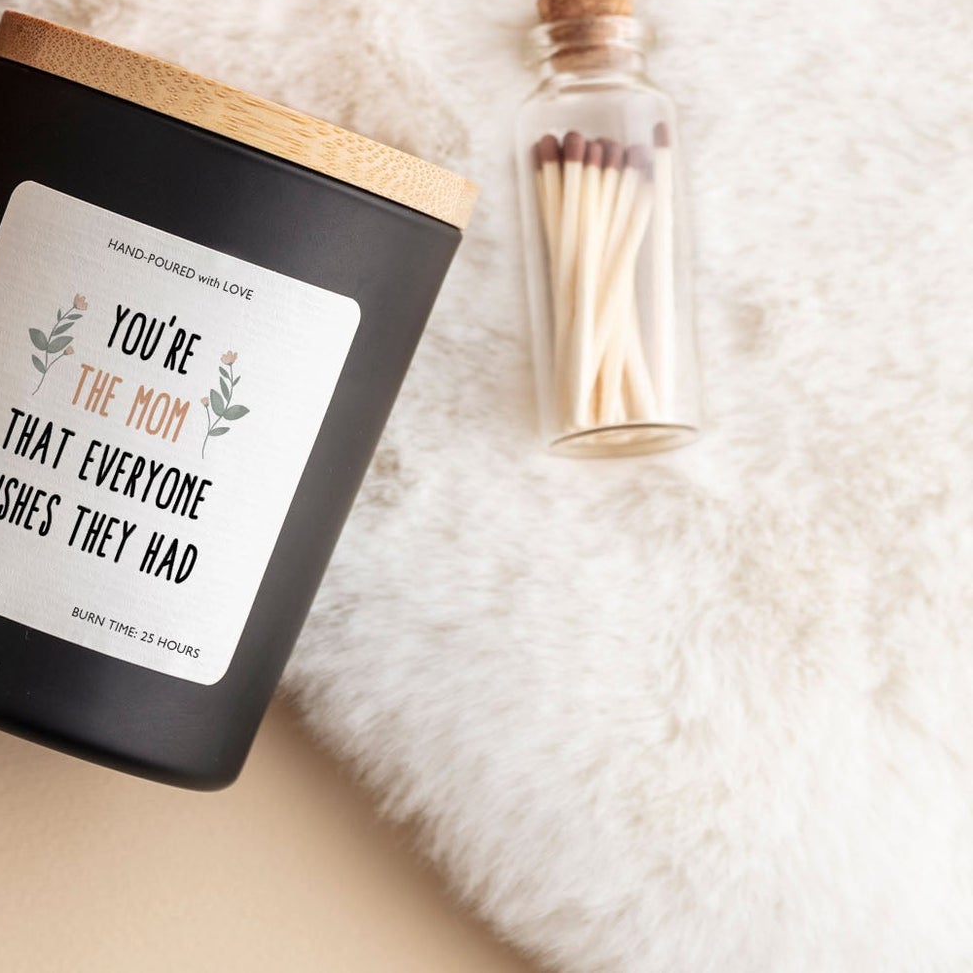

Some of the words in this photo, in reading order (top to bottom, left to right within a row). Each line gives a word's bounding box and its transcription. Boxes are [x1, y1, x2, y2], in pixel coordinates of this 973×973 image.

[107, 237, 196, 280] HAND-POURED
[198, 273, 221, 289] with
[222, 280, 254, 301] LOVE
[106, 303, 202, 376] YOU'RE
[71, 363, 124, 418] THE
[125, 384, 191, 443] MOM
[1, 406, 77, 470] THAT
[77, 439, 213, 521] EVERYONE
[67, 504, 138, 564] THEY
[138, 531, 198, 585] HAD
[71, 606, 106, 627] BURN
[109, 619, 138, 639] TIME:
[140, 630, 155, 644] 25
[156, 636, 201, 659] HOURS
